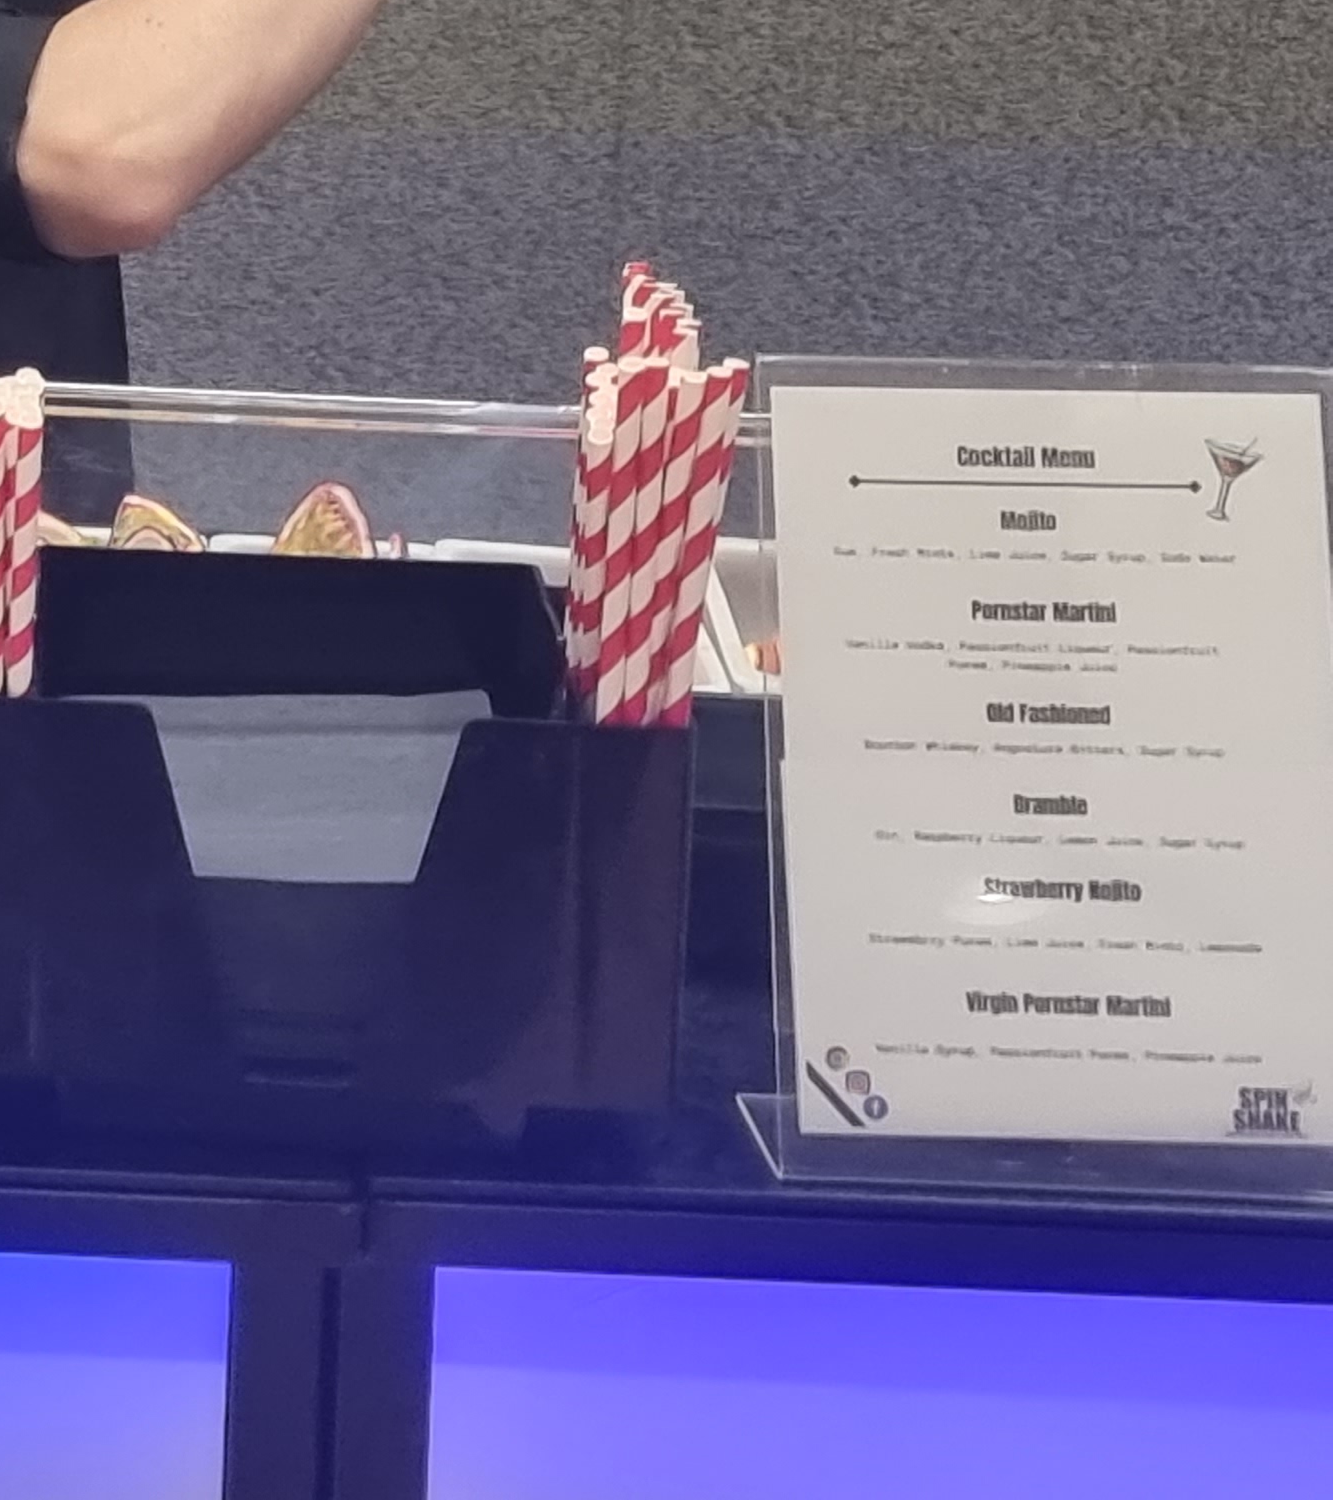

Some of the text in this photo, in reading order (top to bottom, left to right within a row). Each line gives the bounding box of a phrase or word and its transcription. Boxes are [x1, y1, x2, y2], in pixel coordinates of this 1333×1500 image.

[956, 445, 1096, 469] Cocktail Menu
[999, 509, 1057, 533] Mojito
[970, 599, 1117, 624] Pornstar Martini
[985, 701, 1112, 726] Old Fashioned
[983, 876, 1085, 904] Strawberry
[965, 990, 1172, 1018] Virgin Pornstar Martini
[1238, 1086, 1288, 1109] SPIN
[1233, 1109, 1301, 1133] SHAKE
